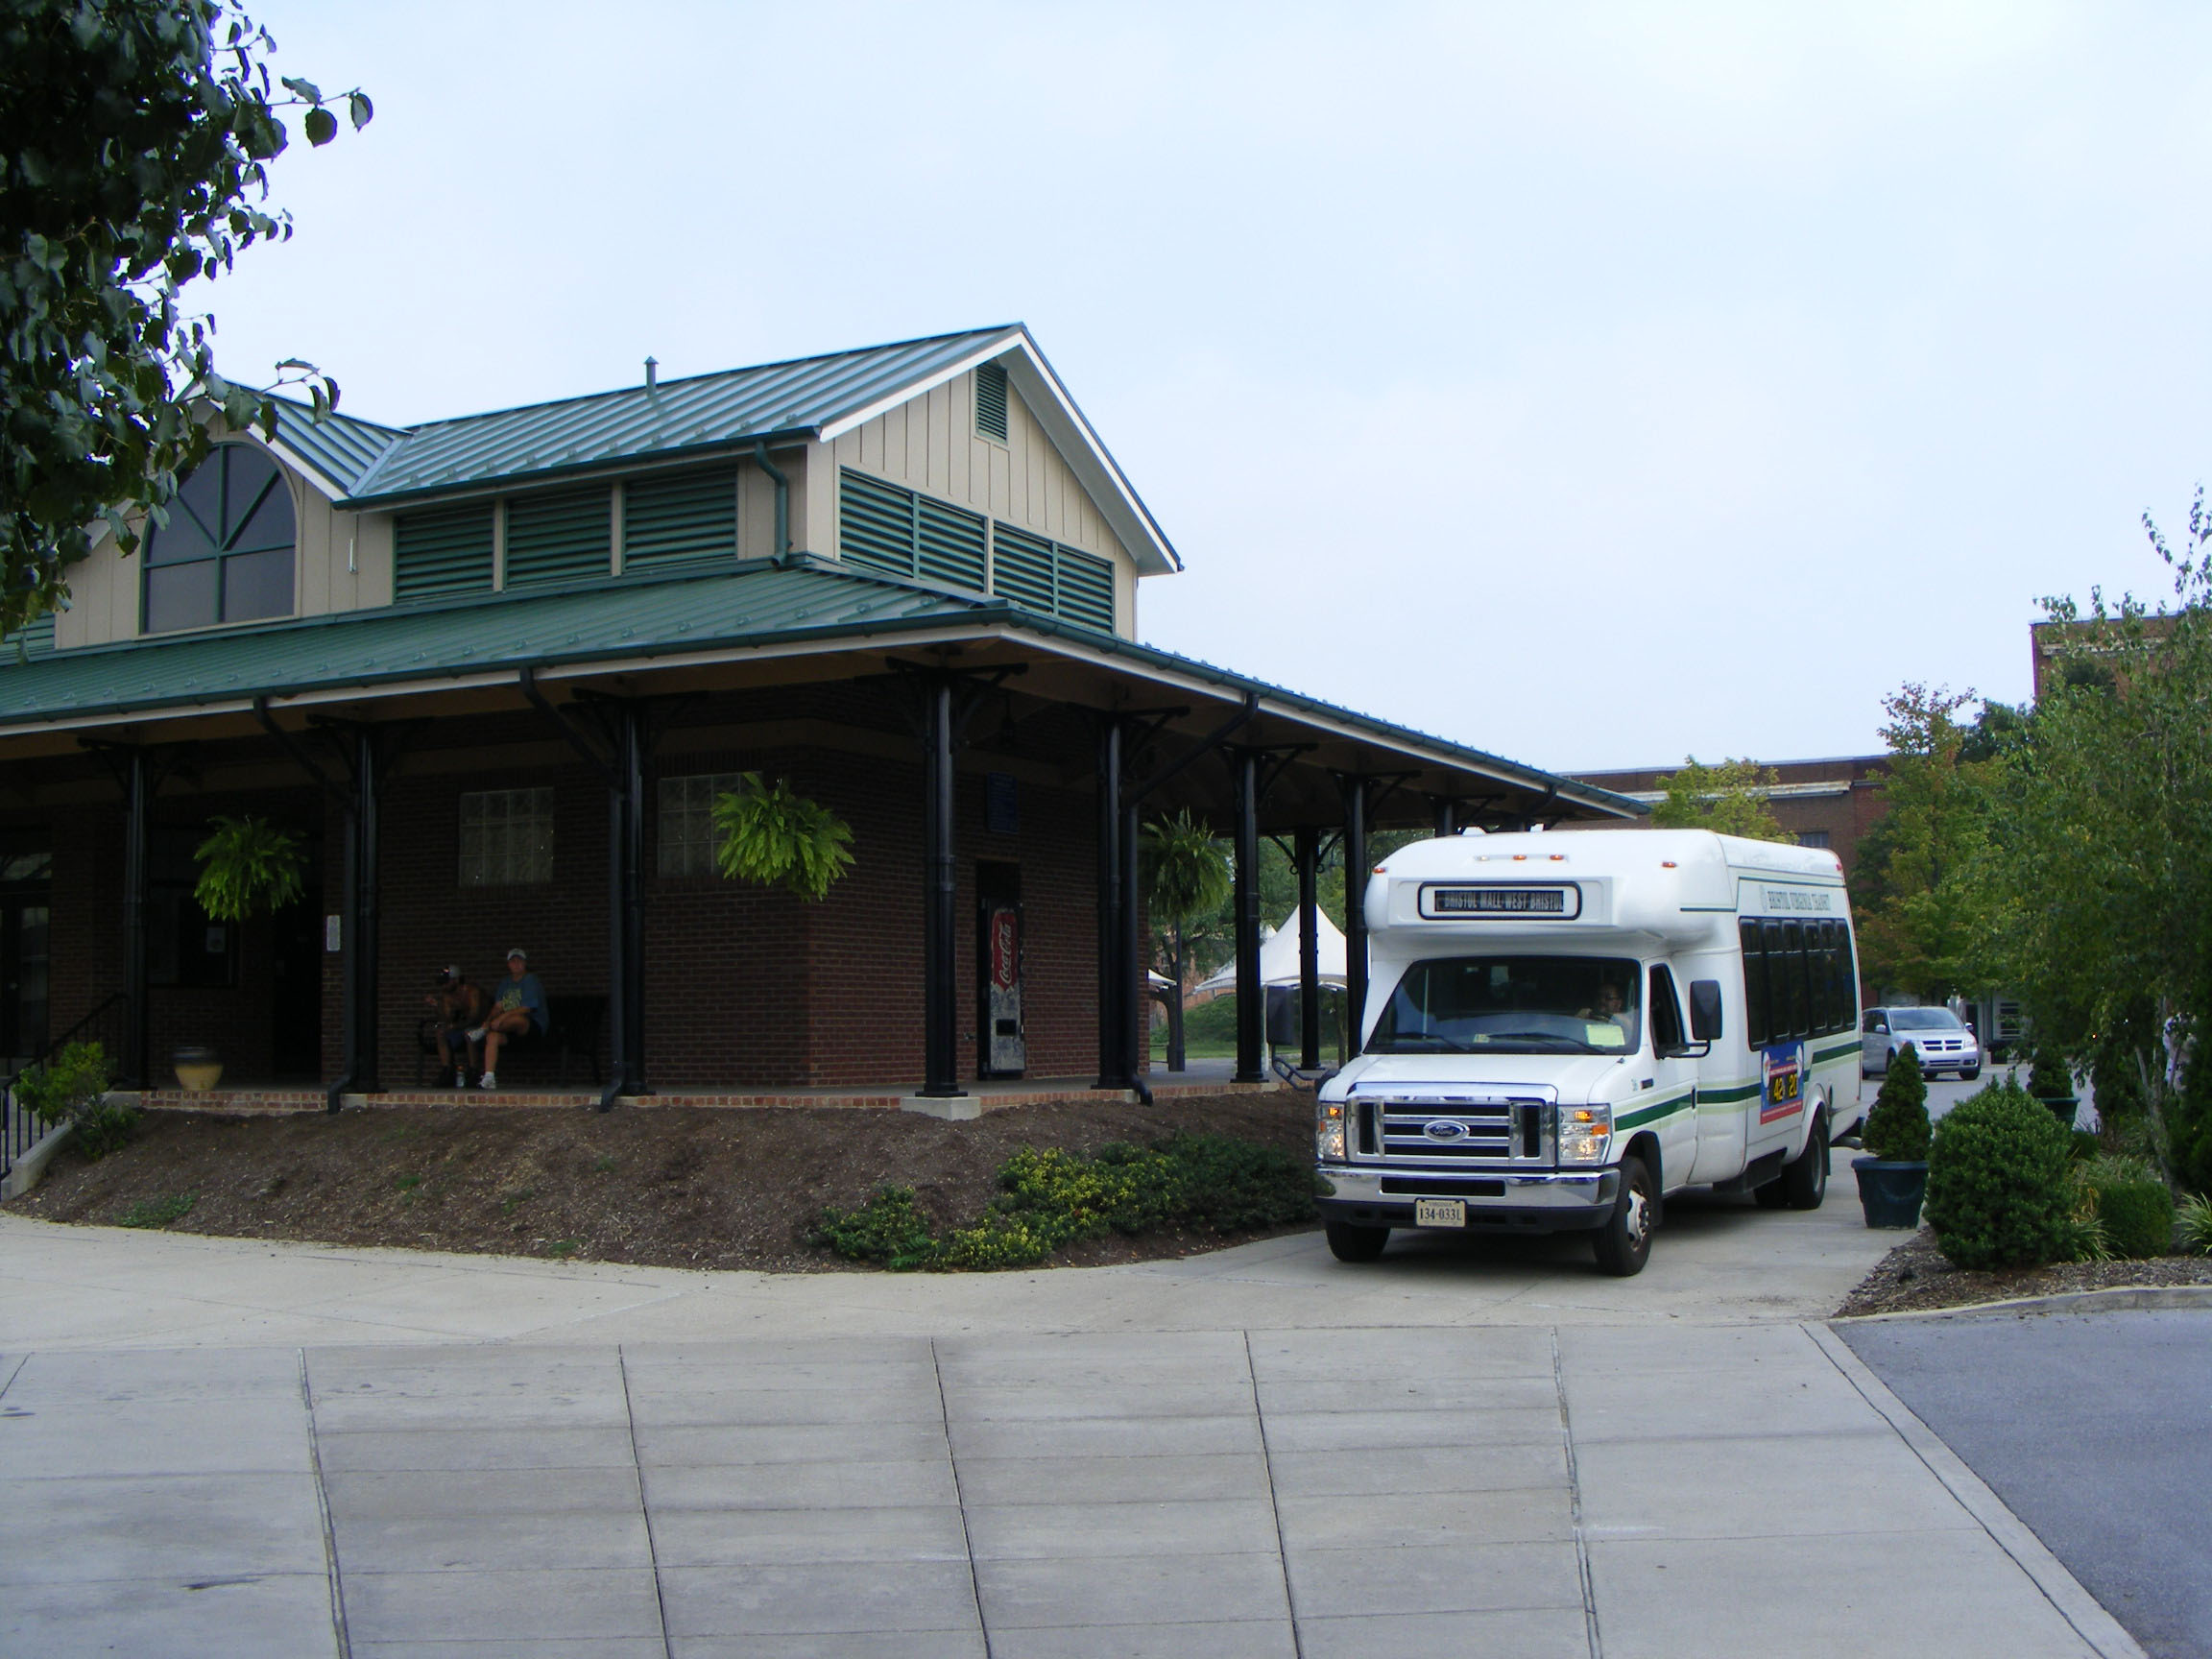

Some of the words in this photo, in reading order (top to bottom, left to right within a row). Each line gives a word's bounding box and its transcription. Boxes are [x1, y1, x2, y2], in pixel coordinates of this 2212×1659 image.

[1444, 892, 1477, 908] BRISTOL
[1505, 892, 1528, 909] WEST
[1530, 893, 1563, 910] BRISTOL
[1420, 1208, 1462, 1220] 134-033L
